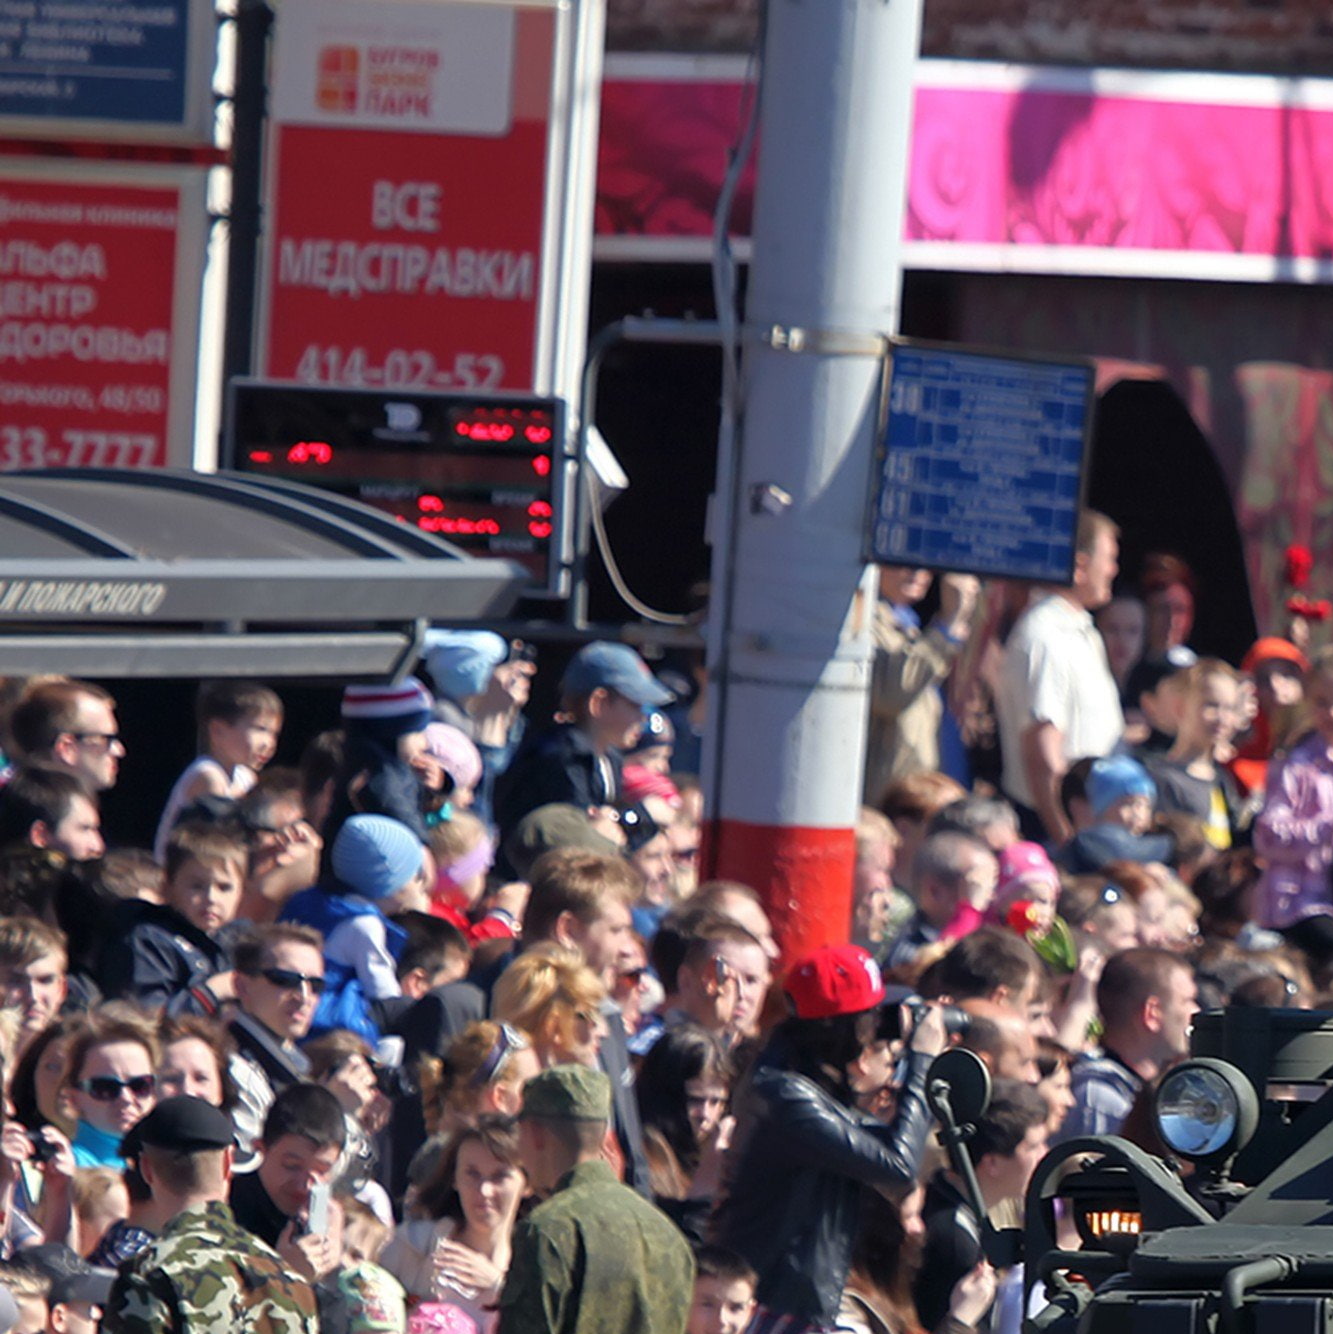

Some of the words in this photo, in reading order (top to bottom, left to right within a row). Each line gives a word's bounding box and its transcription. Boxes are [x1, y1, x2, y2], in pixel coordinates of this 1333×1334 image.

[365, 89, 431, 117] ПАРК
[371, 180, 442, 233] ВСЕ
[279, 238, 535, 301] МЕДСПРАВКИ
[0, 280, 98, 320] ЕНТР
[296, 344, 503, 391] 414-02-52
[0, 580, 26, 612] И
[17, 580, 167, 616] ПОЖАРСКОГО
